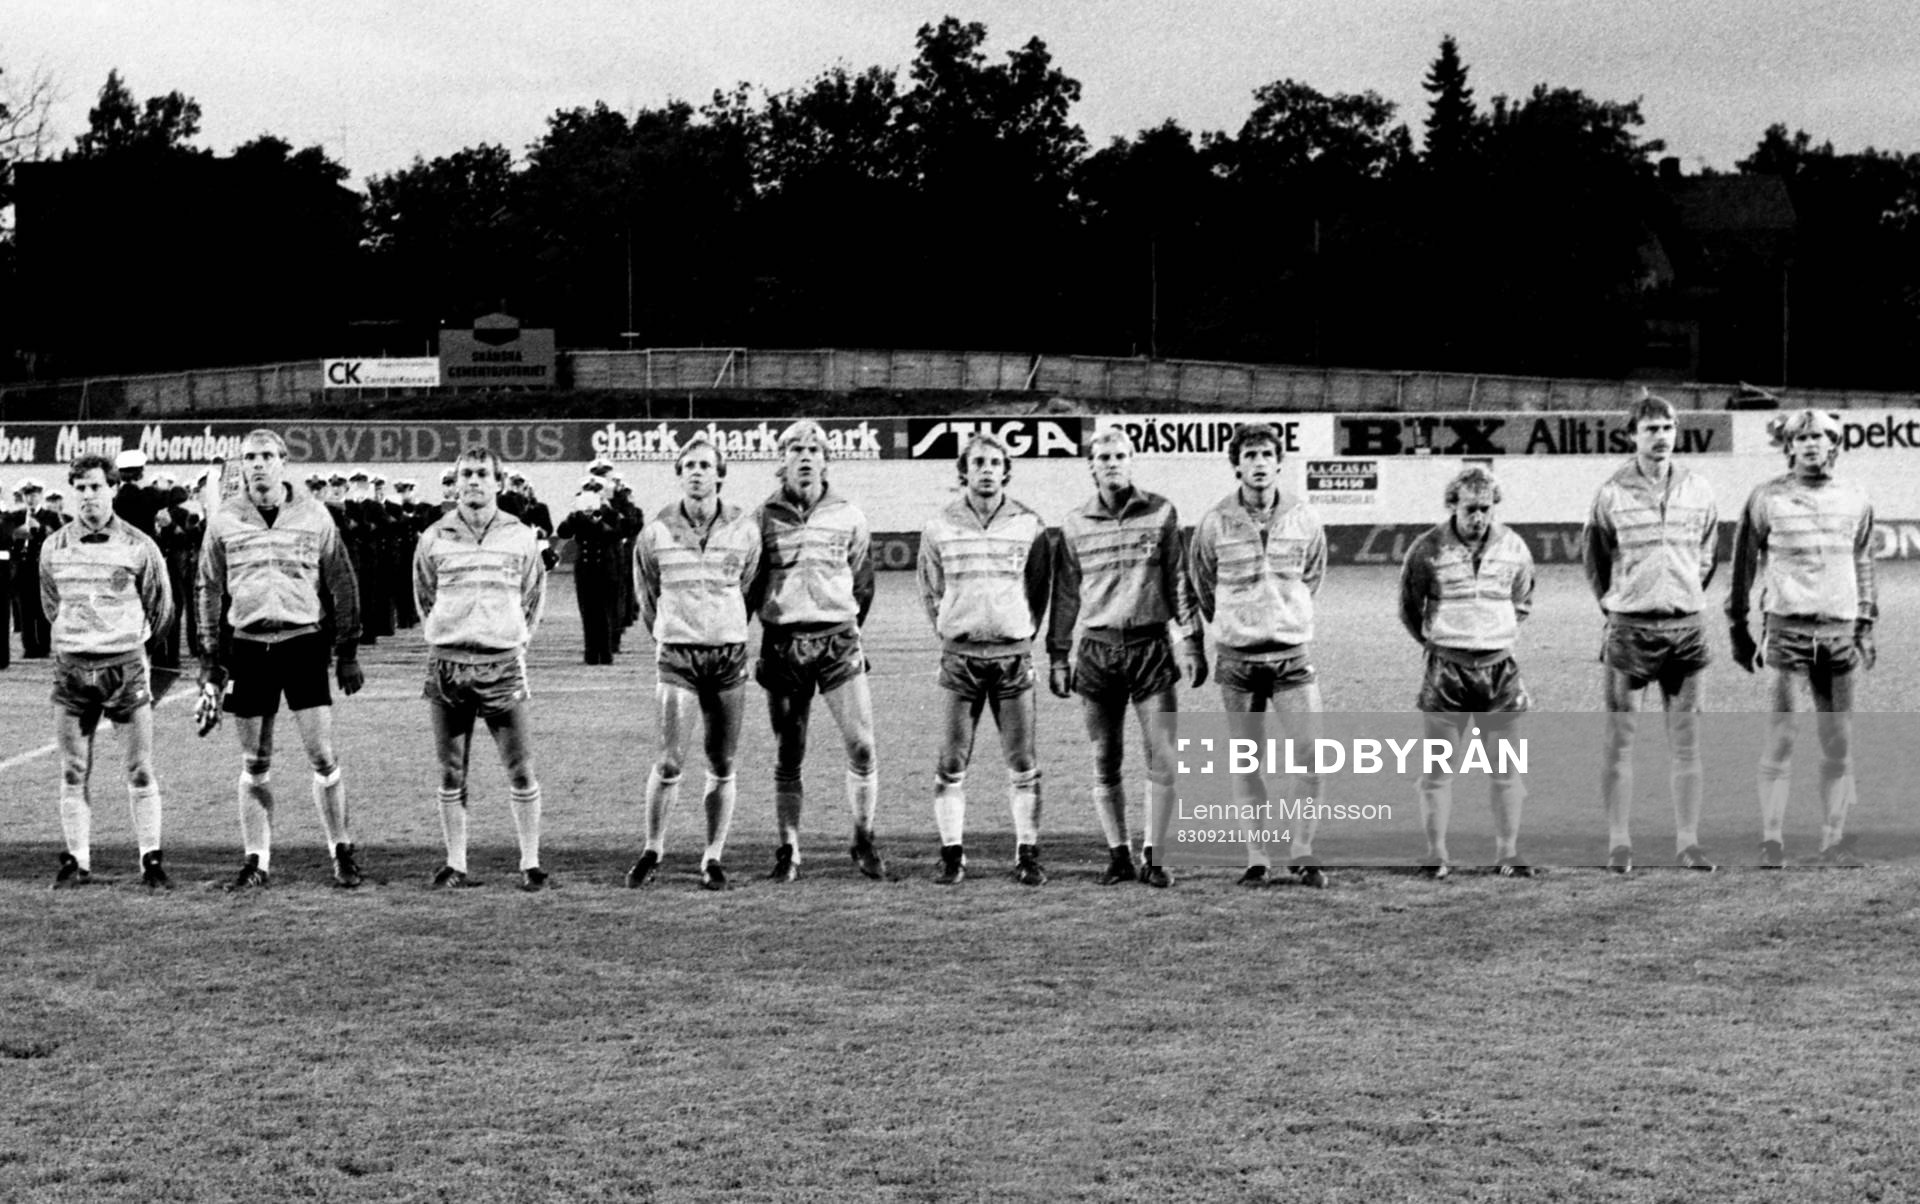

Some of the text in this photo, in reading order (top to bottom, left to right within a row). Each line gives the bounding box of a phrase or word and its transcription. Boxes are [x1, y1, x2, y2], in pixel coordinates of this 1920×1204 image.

[328, 362, 362, 384] CK
[139, 425, 242, 461] Marabou
[284, 426, 564, 461] SWED-HUS
[591, 422, 682, 452] chark
[912, 421, 1078, 457] STIGA
